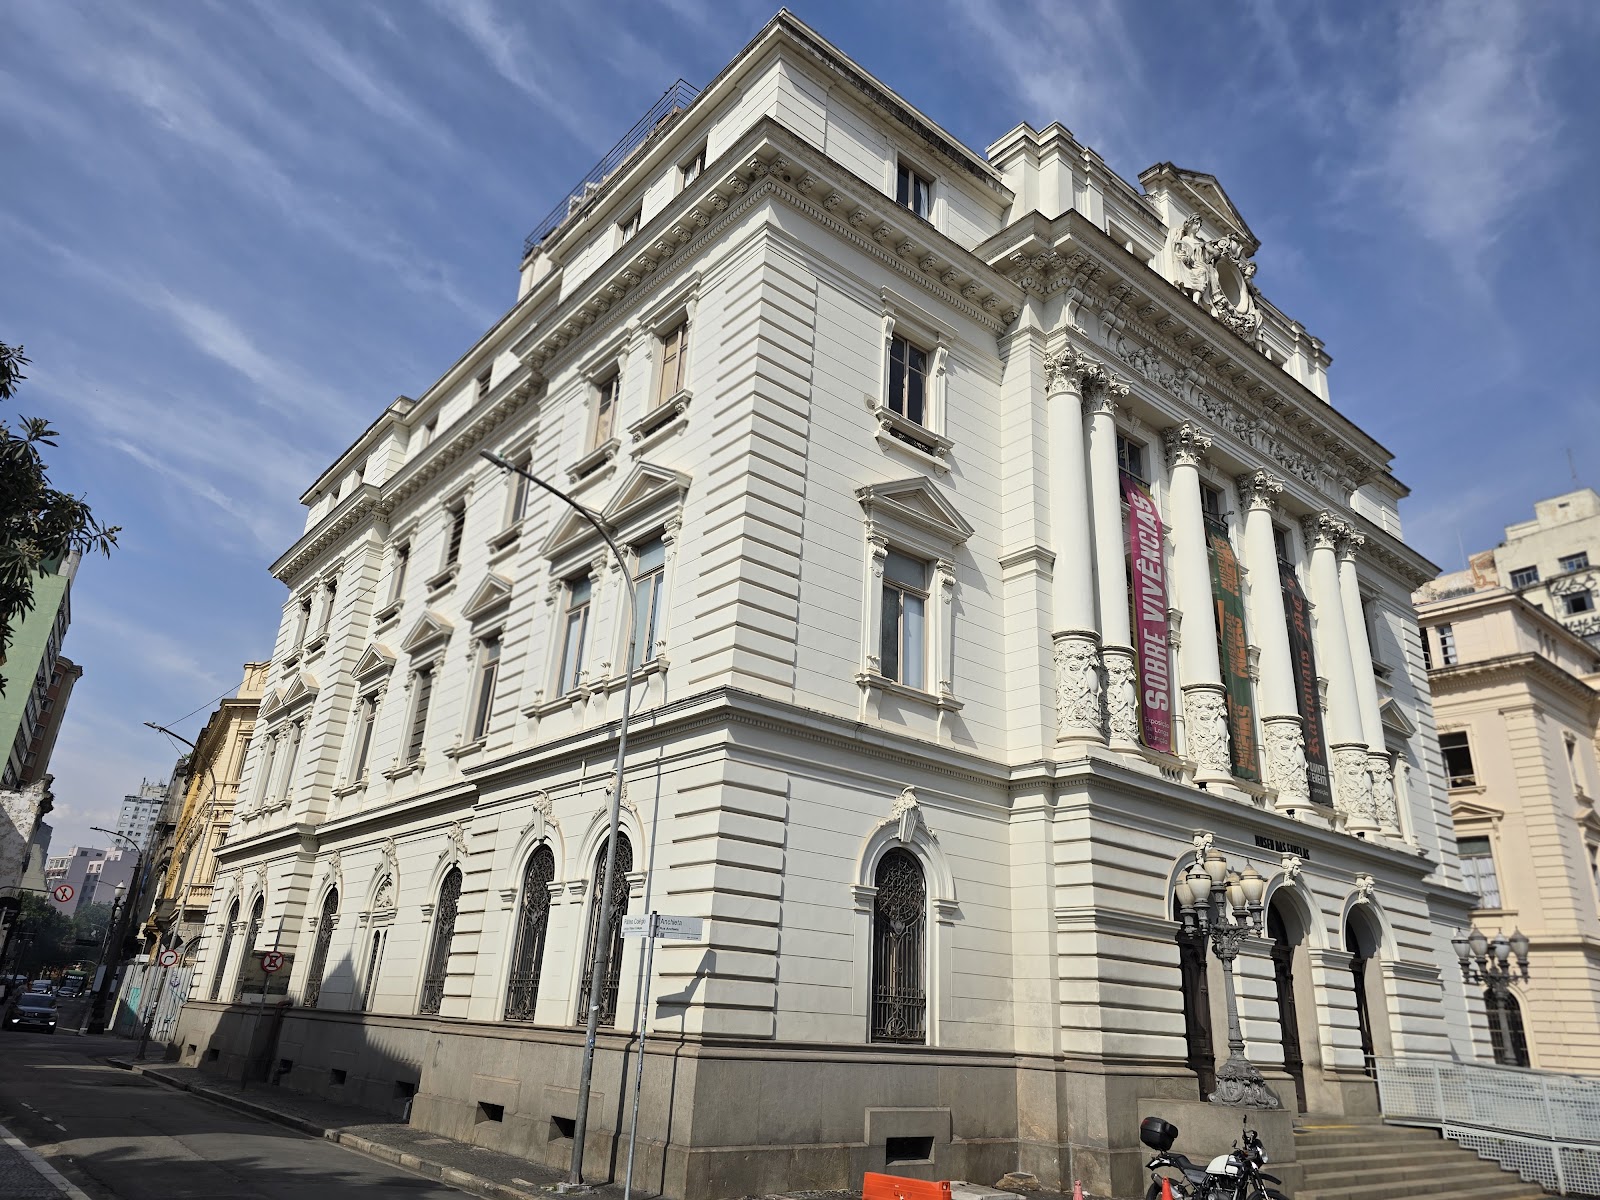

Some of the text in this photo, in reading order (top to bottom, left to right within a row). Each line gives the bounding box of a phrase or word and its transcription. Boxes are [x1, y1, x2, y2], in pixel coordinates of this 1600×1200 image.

[1131, 491, 1169, 712] SOBRE VIVÊNCIAS
[1227, 630, 1239, 673] MUSEU
[1301, 650, 1320, 759] Racionais
[1234, 729, 1246, 767] MUSEU
[1254, 834, 1275, 850] MUSEU
[1275, 841, 1287, 852] DAS
